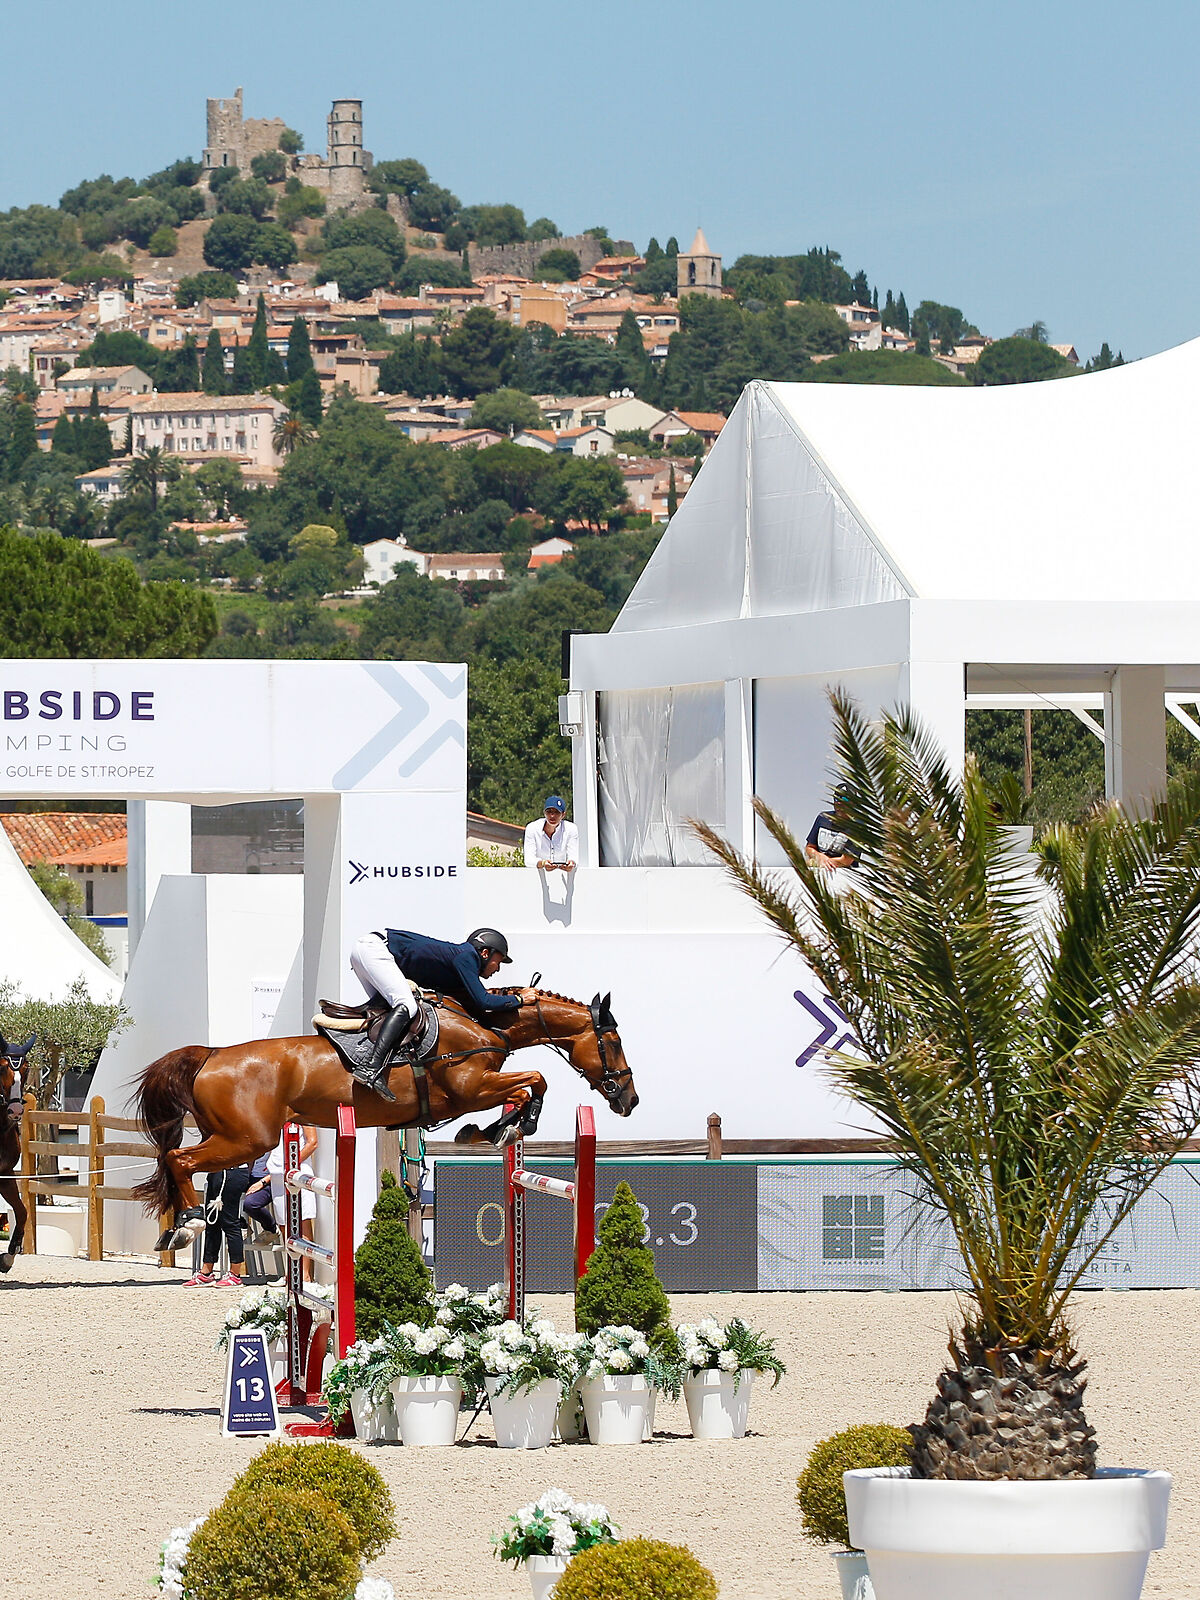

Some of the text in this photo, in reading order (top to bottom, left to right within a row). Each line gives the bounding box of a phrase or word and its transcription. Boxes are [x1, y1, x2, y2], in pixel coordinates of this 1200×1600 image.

[6, 764, 53, 778] GOLFE
[58, 764, 77, 778] DE
[373, 865, 458, 878] HUBSIDE
[235, 1377, 265, 1402] 13
